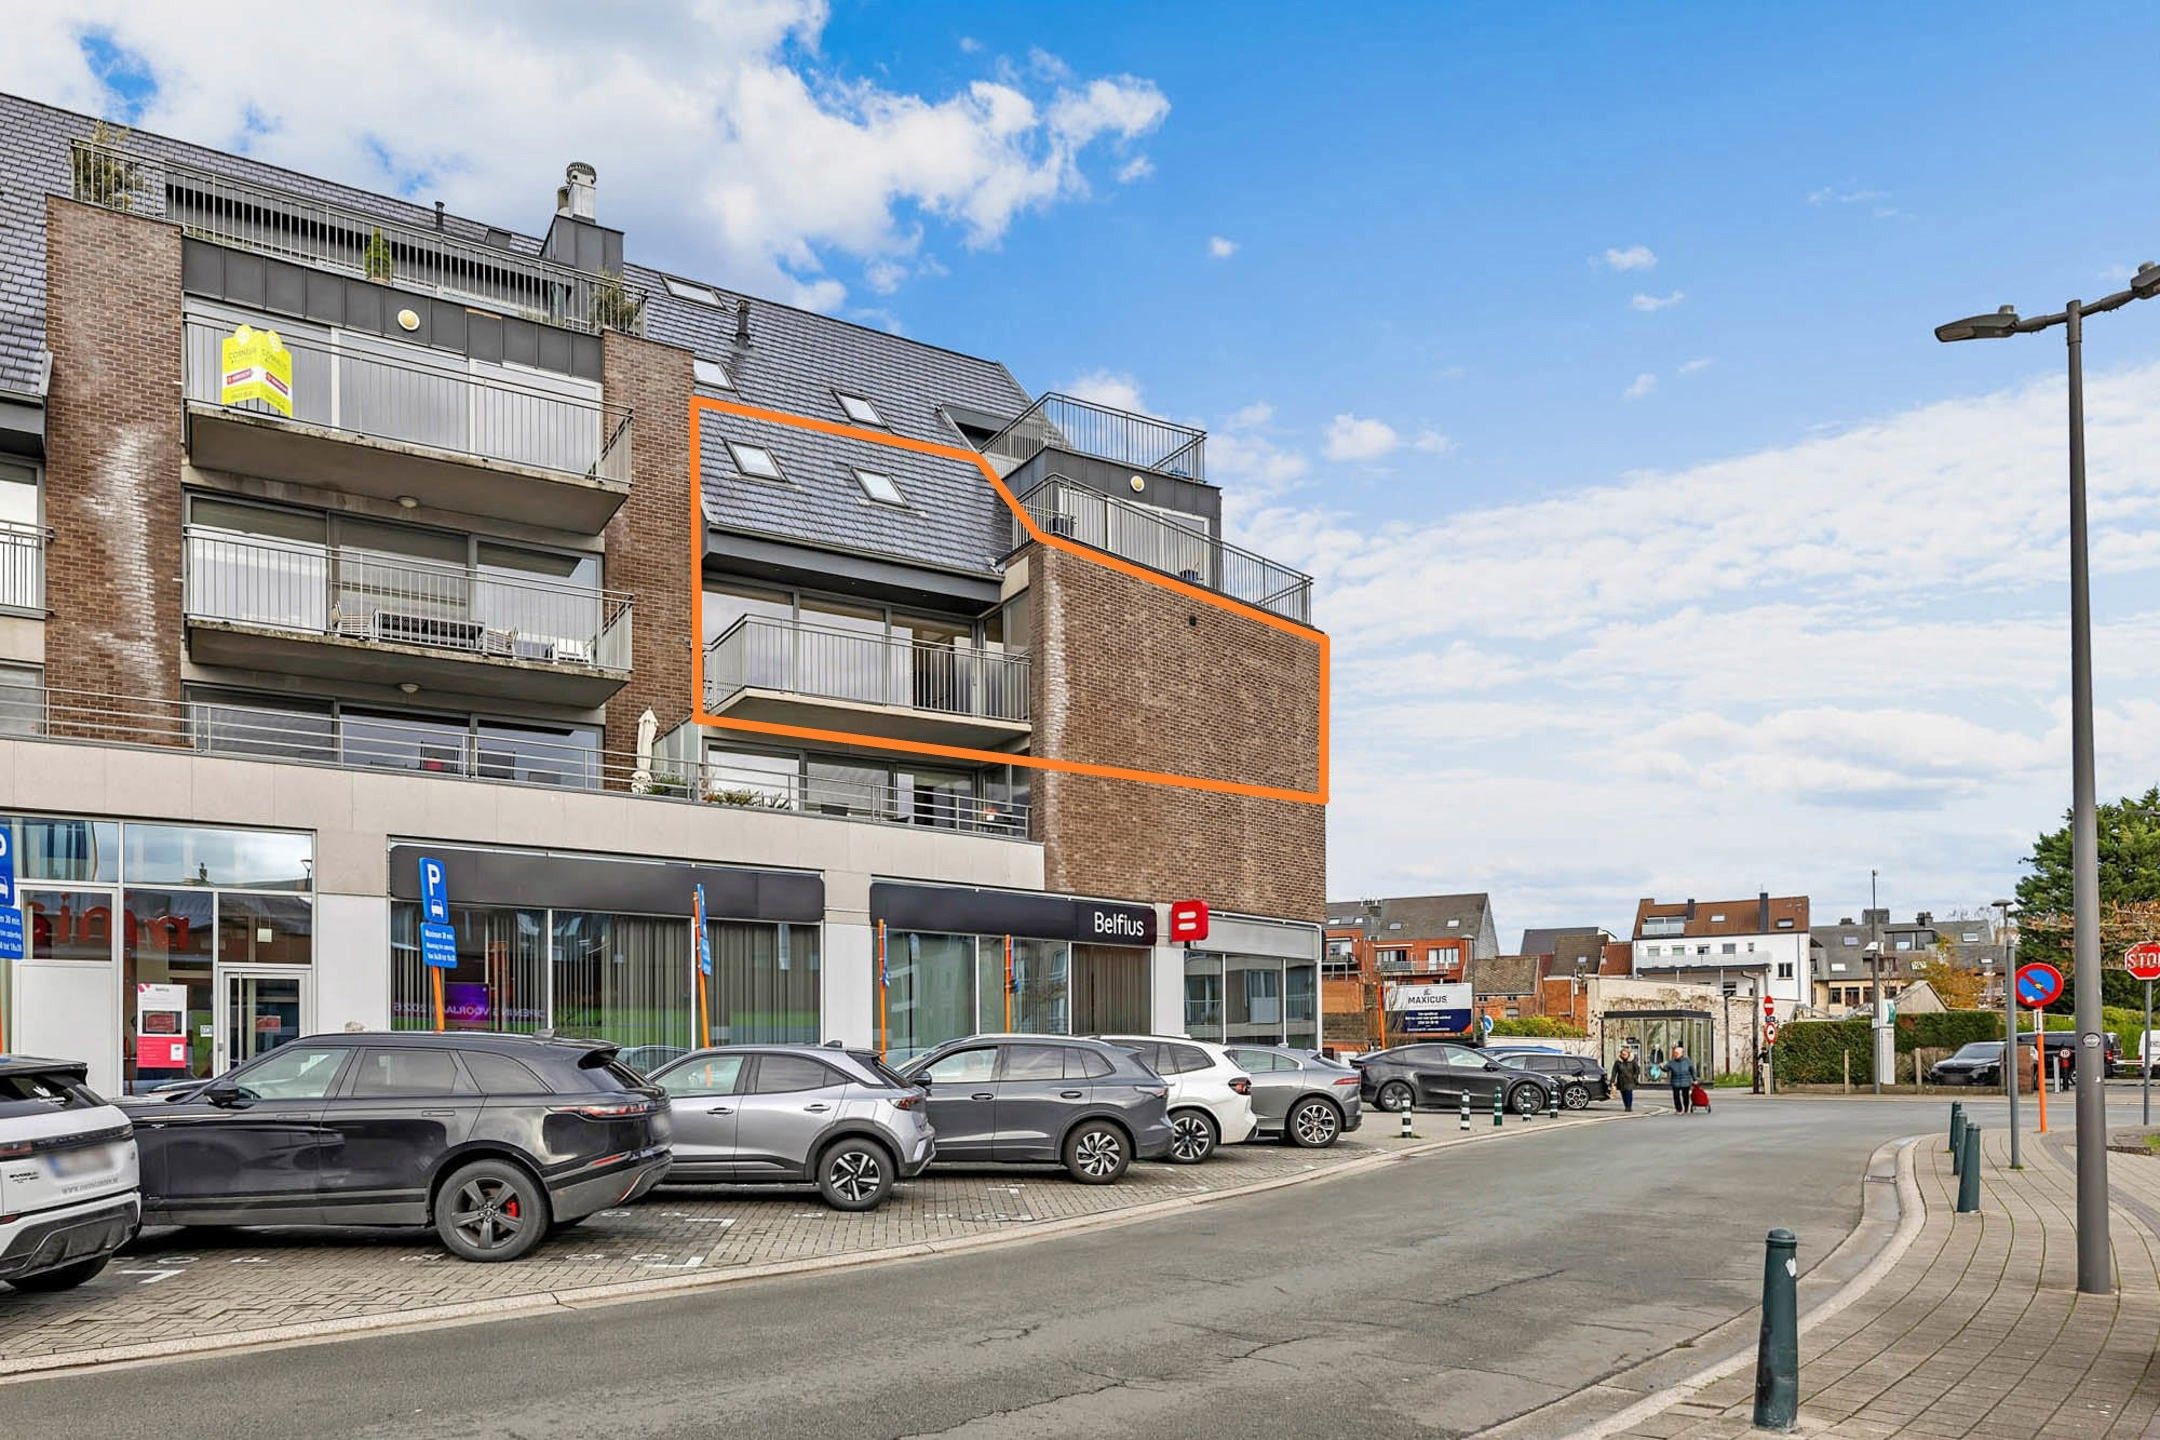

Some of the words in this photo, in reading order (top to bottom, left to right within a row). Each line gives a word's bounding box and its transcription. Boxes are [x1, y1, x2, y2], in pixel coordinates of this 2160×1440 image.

[427, 863, 441, 897] P
[1094, 911, 1144, 936] Belfius
[1407, 995, 1448, 1004] MAXICUS
